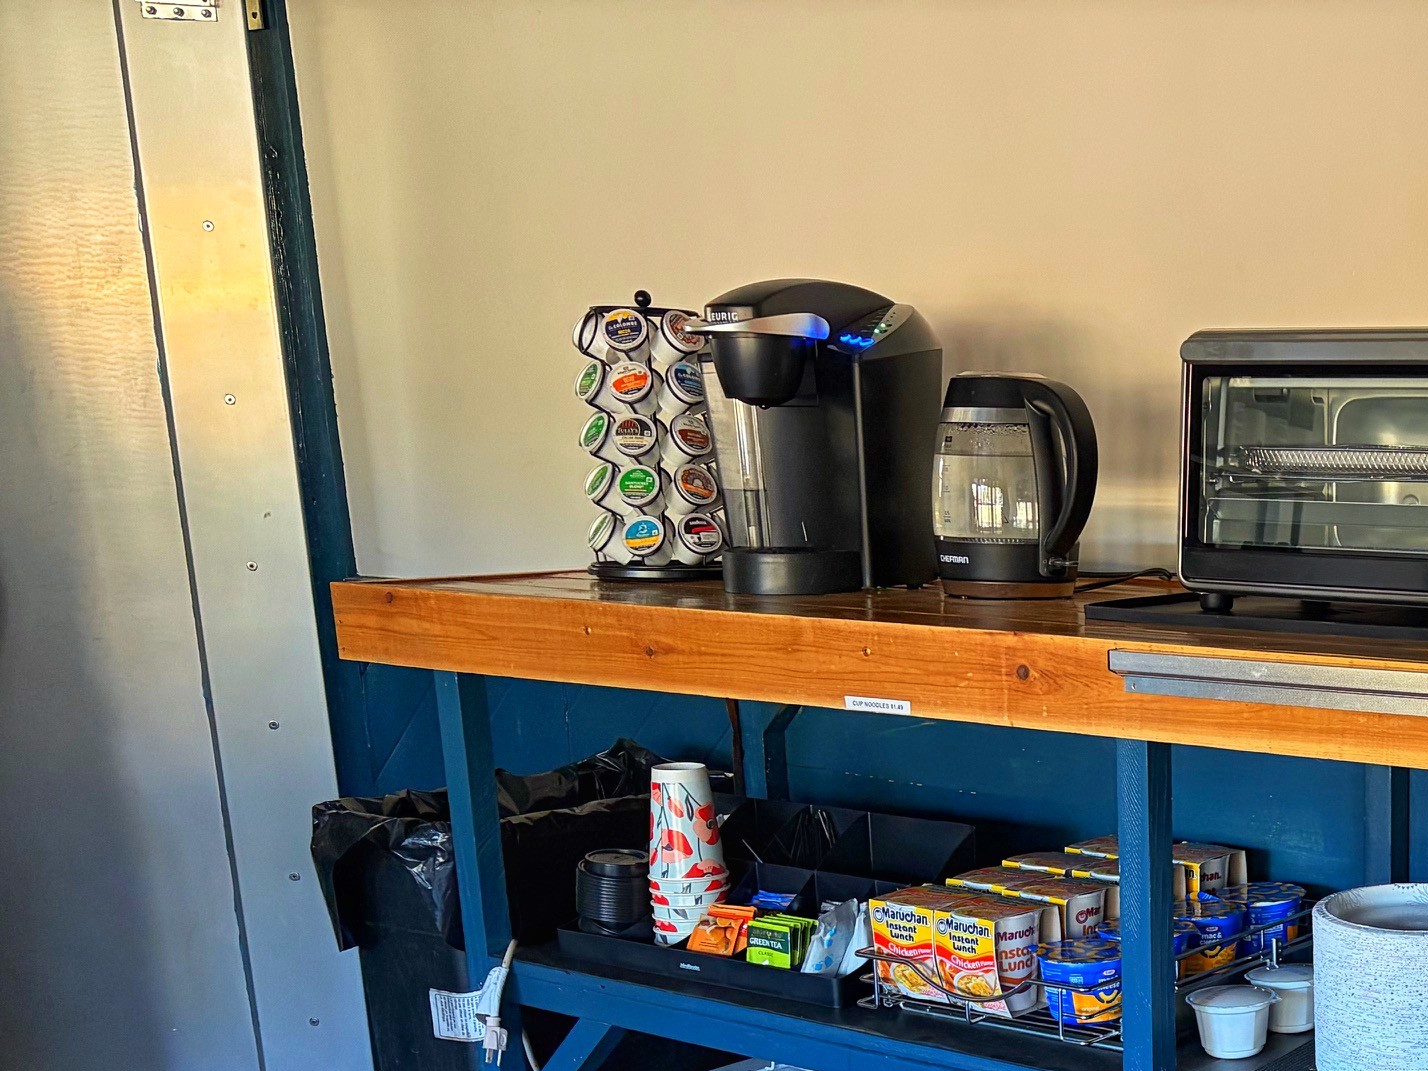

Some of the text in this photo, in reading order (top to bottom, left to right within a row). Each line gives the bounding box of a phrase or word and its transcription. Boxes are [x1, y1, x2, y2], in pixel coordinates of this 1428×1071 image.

[711, 311, 738, 321] EURIG
[940, 554, 969, 564] CHEFMAN
[864, 701, 889, 709] NOODLES
[886, 920, 917, 934] Instant
[889, 930, 914, 942] Lunch
[949, 932, 979, 946] Instant
[749, 937, 783, 949] GREEN TEA
[953, 942, 977, 955] Lunch
[888, 943, 918, 956] Chicken
[951, 955, 981, 969] Chicken
